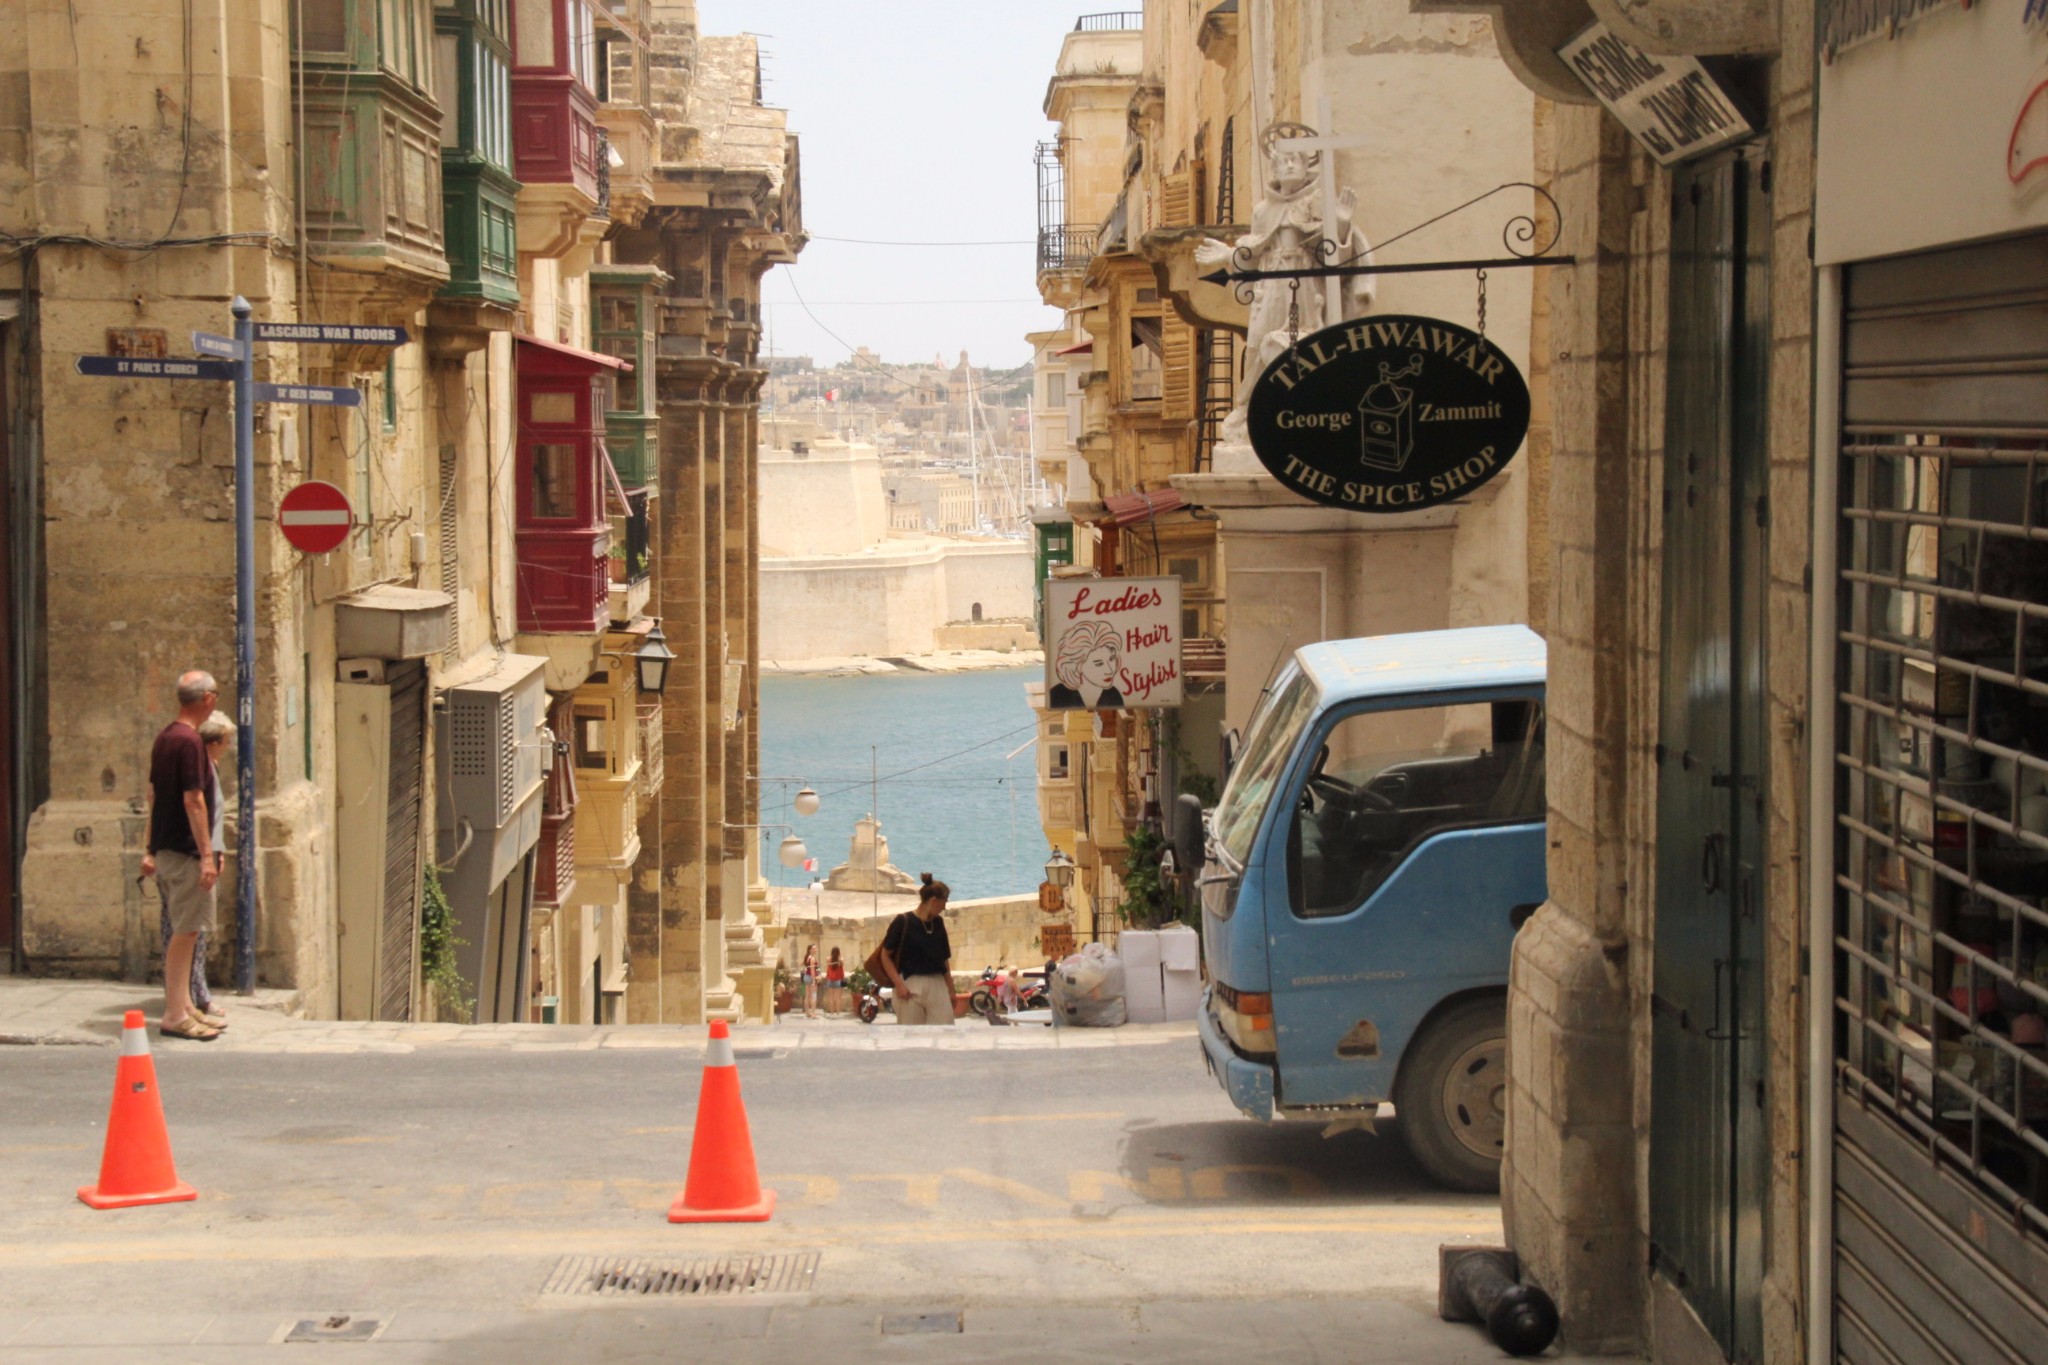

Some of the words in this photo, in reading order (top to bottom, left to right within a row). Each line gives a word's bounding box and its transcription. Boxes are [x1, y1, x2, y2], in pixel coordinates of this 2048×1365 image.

[1639, 70, 1736, 147] ZAMMIT
[259, 325, 320, 338] LASCARIS
[323, 327, 350, 339] WAR
[353, 328, 396, 341] ROOMS
[117, 361, 128, 372] ST
[133, 362, 161, 373] PAUL'S
[164, 364, 198, 375] CHURCH
[1276, 410, 1352, 431] George
[1419, 400, 1502, 422] Zammit
[1281, 454, 1336, 496] THE
[1341, 482, 1424, 505] SPICE
[1429, 445, 1498, 497] SHOP
[1068, 586, 1162, 619] Ladies
[1126, 624, 1172, 653] Hair
[1120, 658, 1177, 701] Stylist
